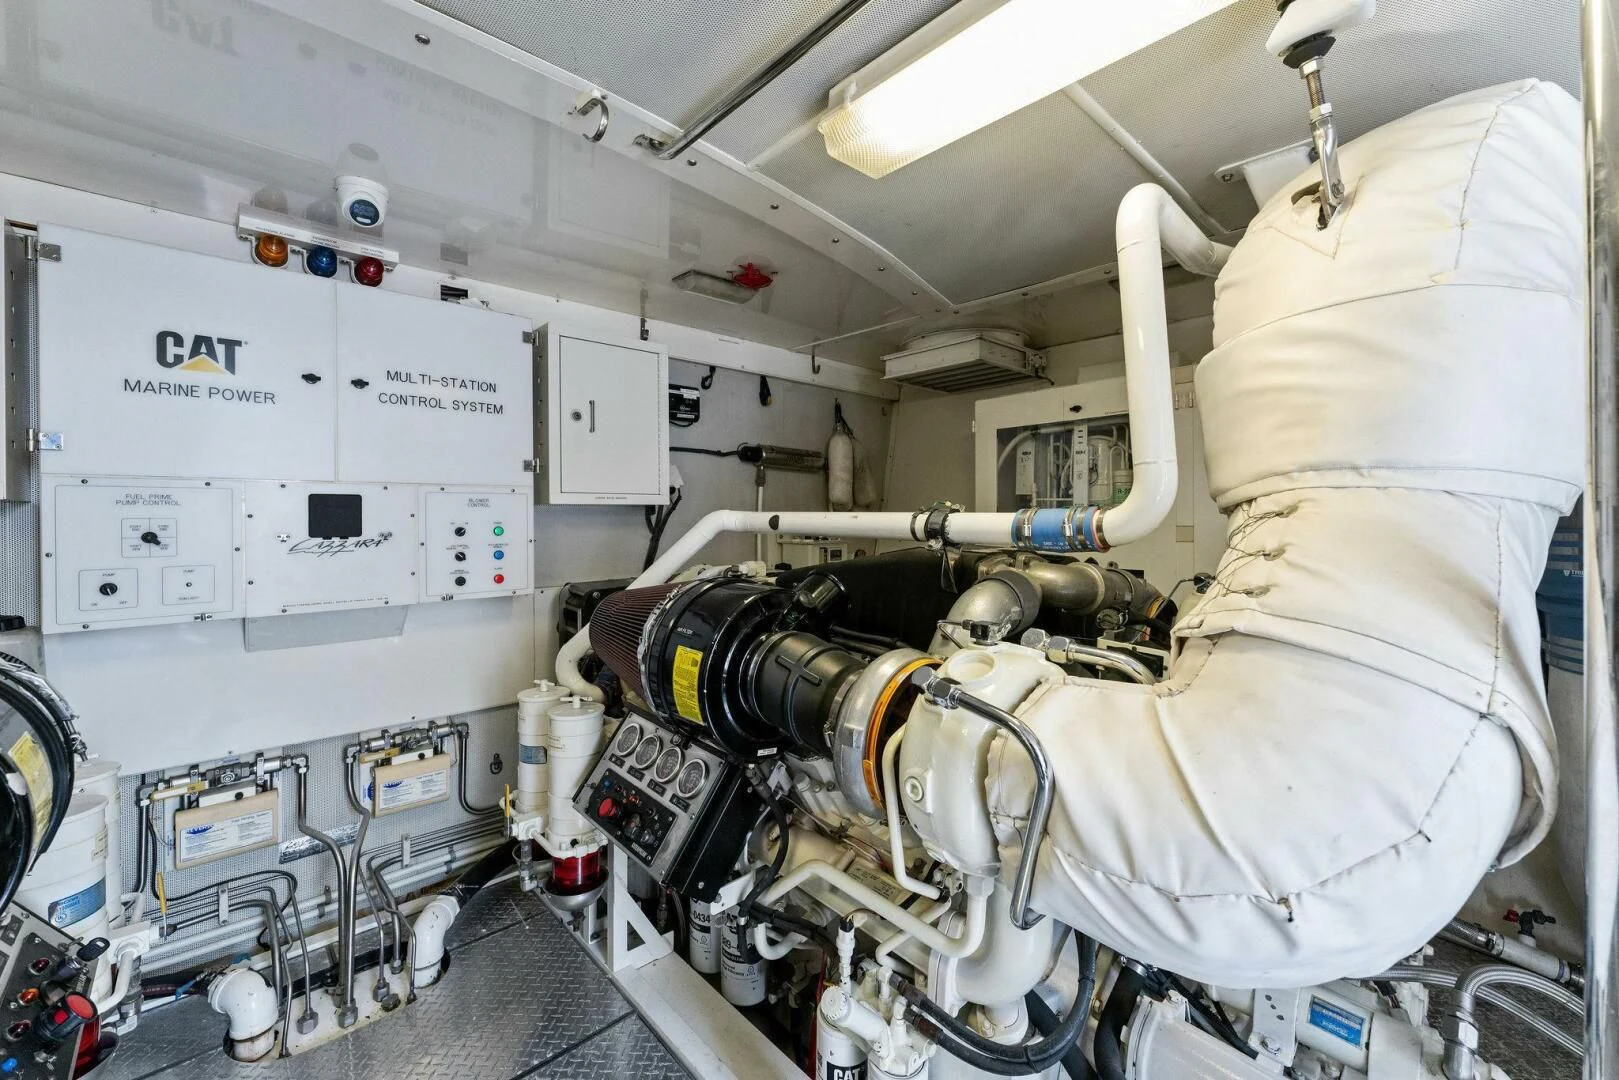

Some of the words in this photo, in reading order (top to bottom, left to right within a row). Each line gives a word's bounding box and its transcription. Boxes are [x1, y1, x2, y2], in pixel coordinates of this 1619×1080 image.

[156, 330, 242, 376] CAT
[123, 378, 200, 398] MARINE
[208, 386, 276, 405] POWER
[386, 369, 497, 393] MULTI-STATION
[378, 392, 447, 410] CONTROL
[452, 399, 504, 415] SYSTEM
